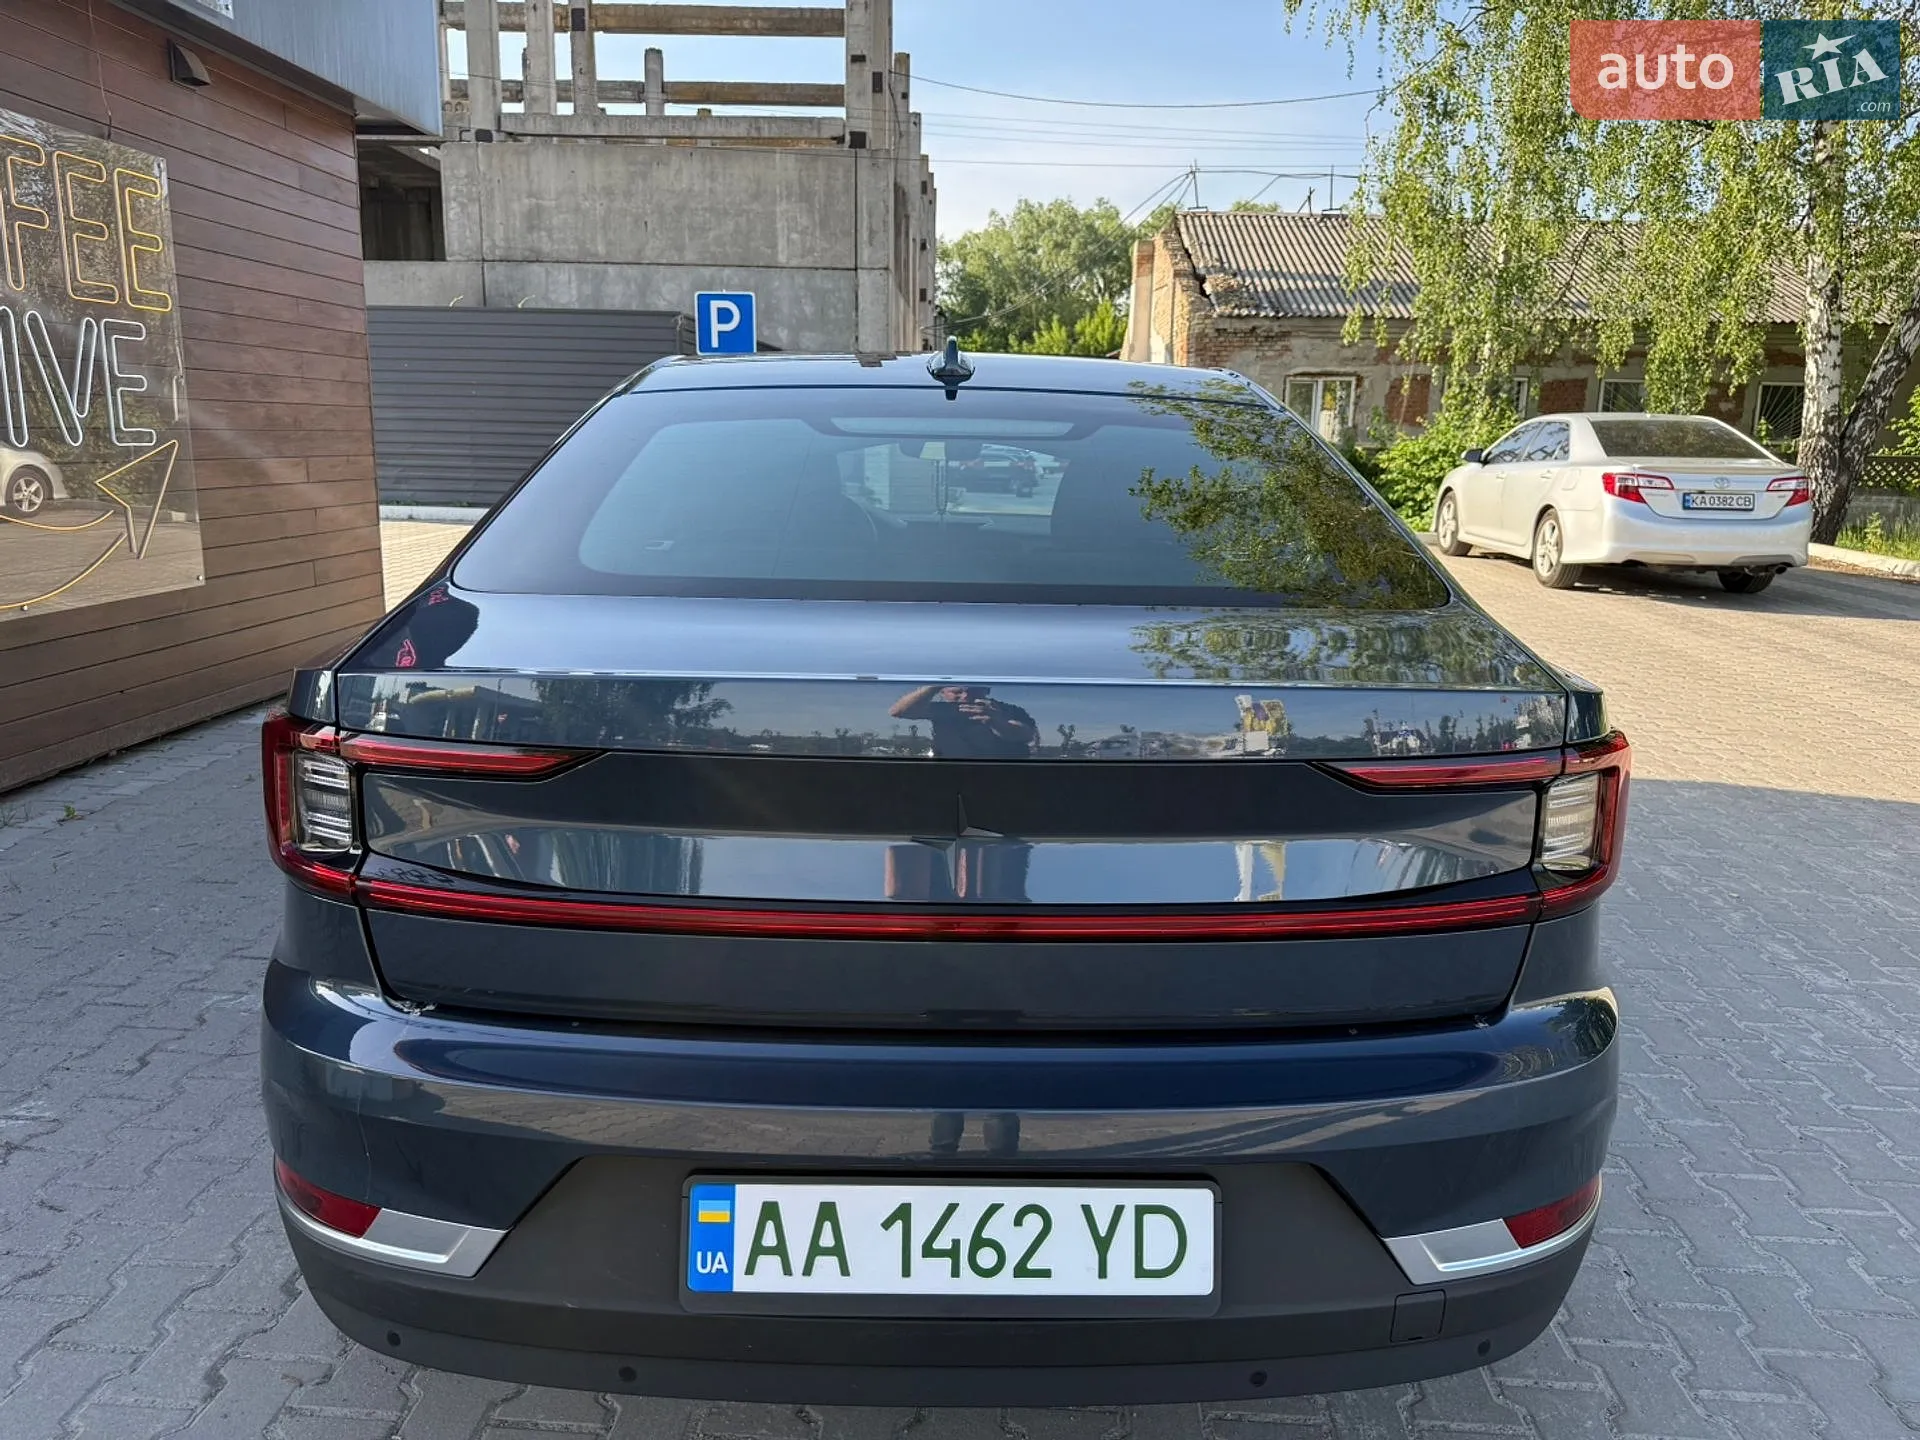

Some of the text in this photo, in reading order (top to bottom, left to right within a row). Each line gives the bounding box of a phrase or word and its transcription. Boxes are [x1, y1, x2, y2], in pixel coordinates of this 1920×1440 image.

[710, 300, 740, 348] P
[1709, 496, 1734, 506] 0382
[743, 1200, 1188, 1279] AA 1462 YD
[696, 1251, 729, 1274] UA
